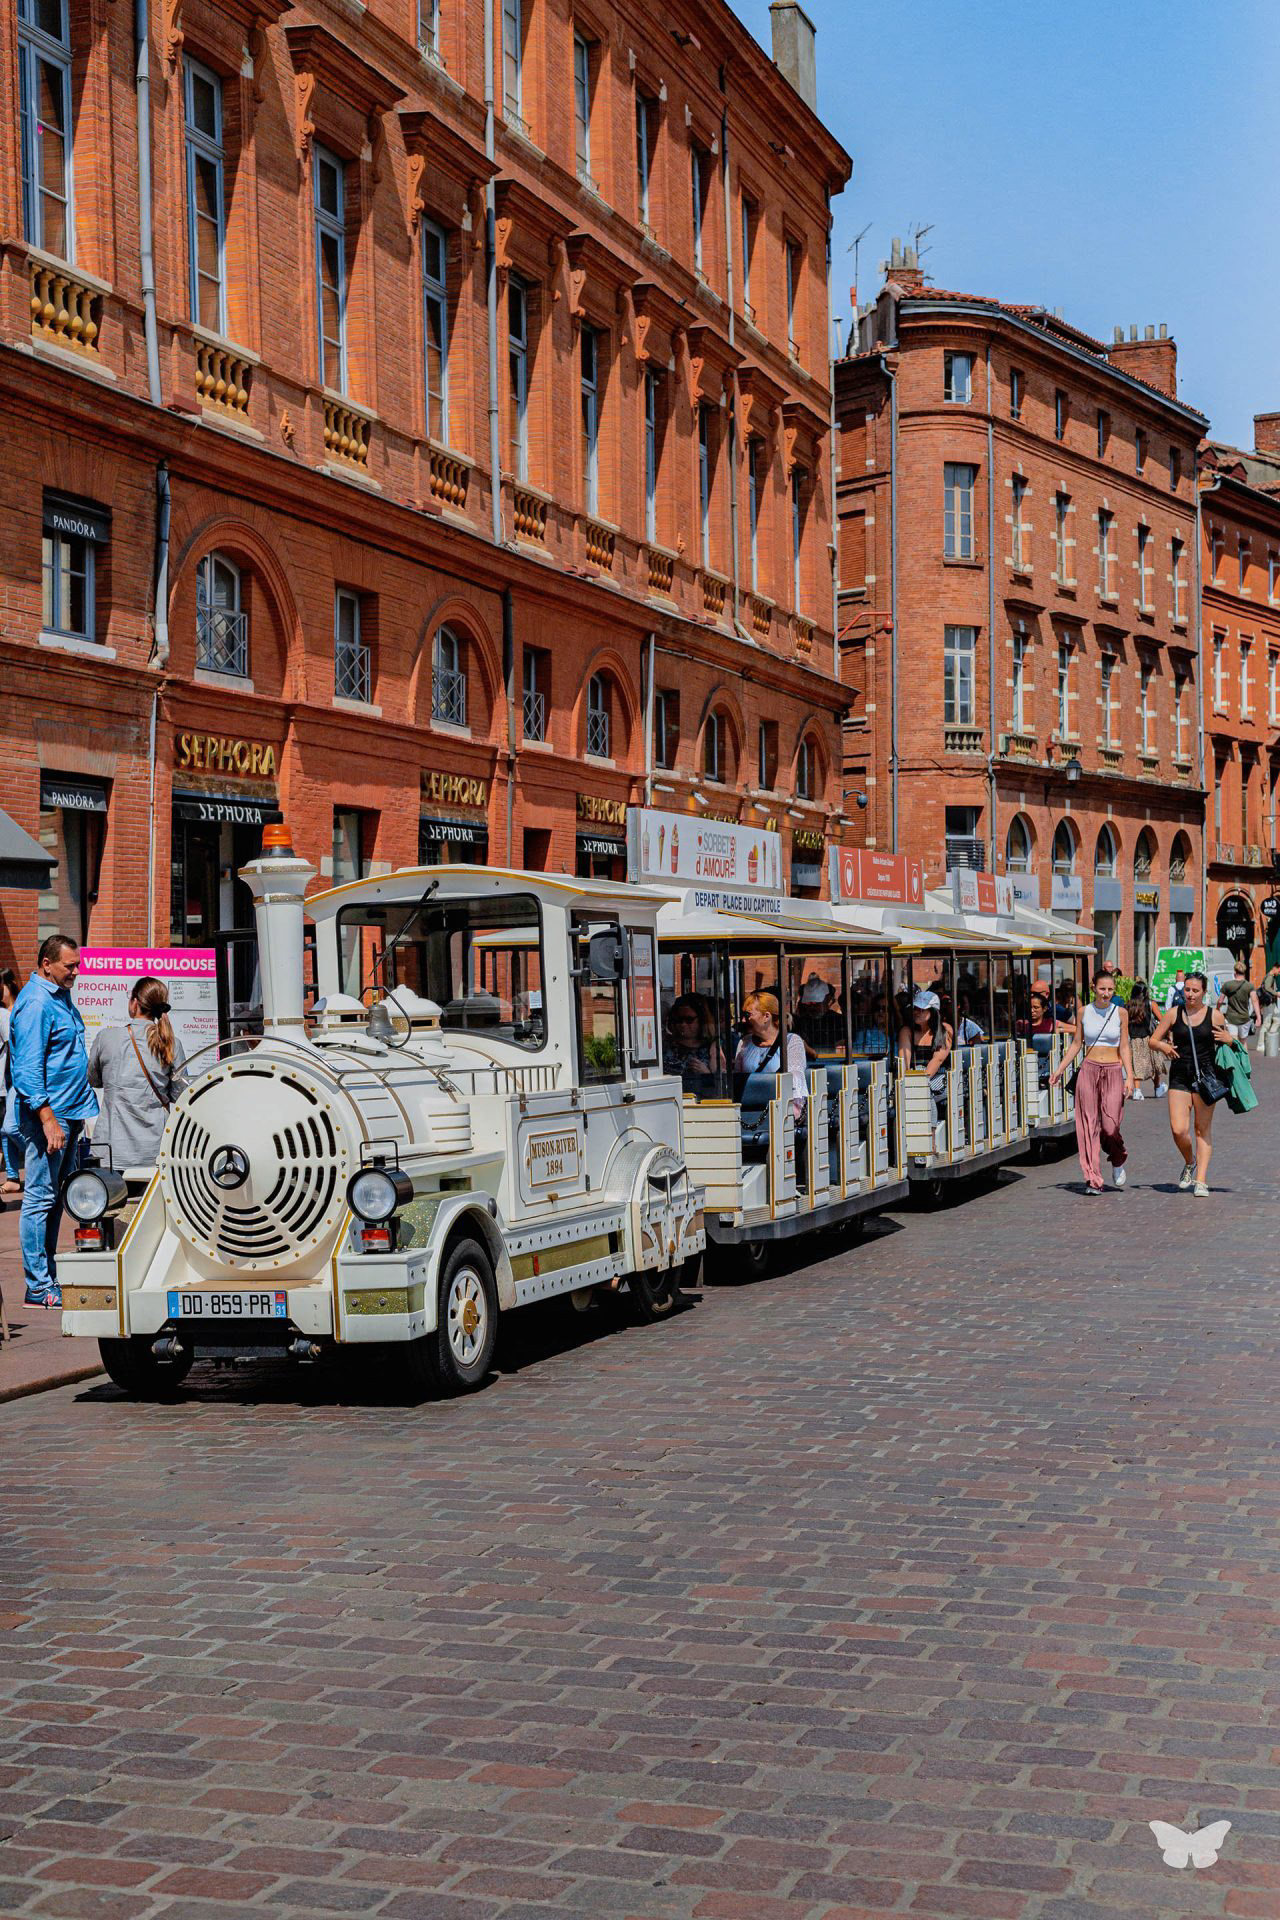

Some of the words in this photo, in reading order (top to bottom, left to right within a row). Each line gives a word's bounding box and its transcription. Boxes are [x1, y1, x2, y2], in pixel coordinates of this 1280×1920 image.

[53, 515, 96, 538] PANDORA
[179, 733, 276, 776] SEPHORA
[423, 771, 487, 806] SEPHORA
[52, 791, 95, 809] PANDORA
[199, 803, 262, 824] SEPHORA
[429, 824, 474, 842] SEPHORA
[583, 839, 619, 855] SEPHORA
[703, 831, 730, 856] SORBET
[723, 894, 742, 911] PLACE
[743, 897, 752, 911] DU
[753, 899, 781, 913] CAPITOLE
[83, 957, 123, 969] VISITE
[126, 958, 143, 970] DE
[146, 958, 216, 971] TOULOUSE
[77, 983, 128, 992] PROCHAIN
[77, 996, 113, 1006] DÉPART
[546, 1159, 563, 1175] 1894
[182, 1295, 271, 1314] DD-859-PR
[276, 1305, 286, 1315] 31
